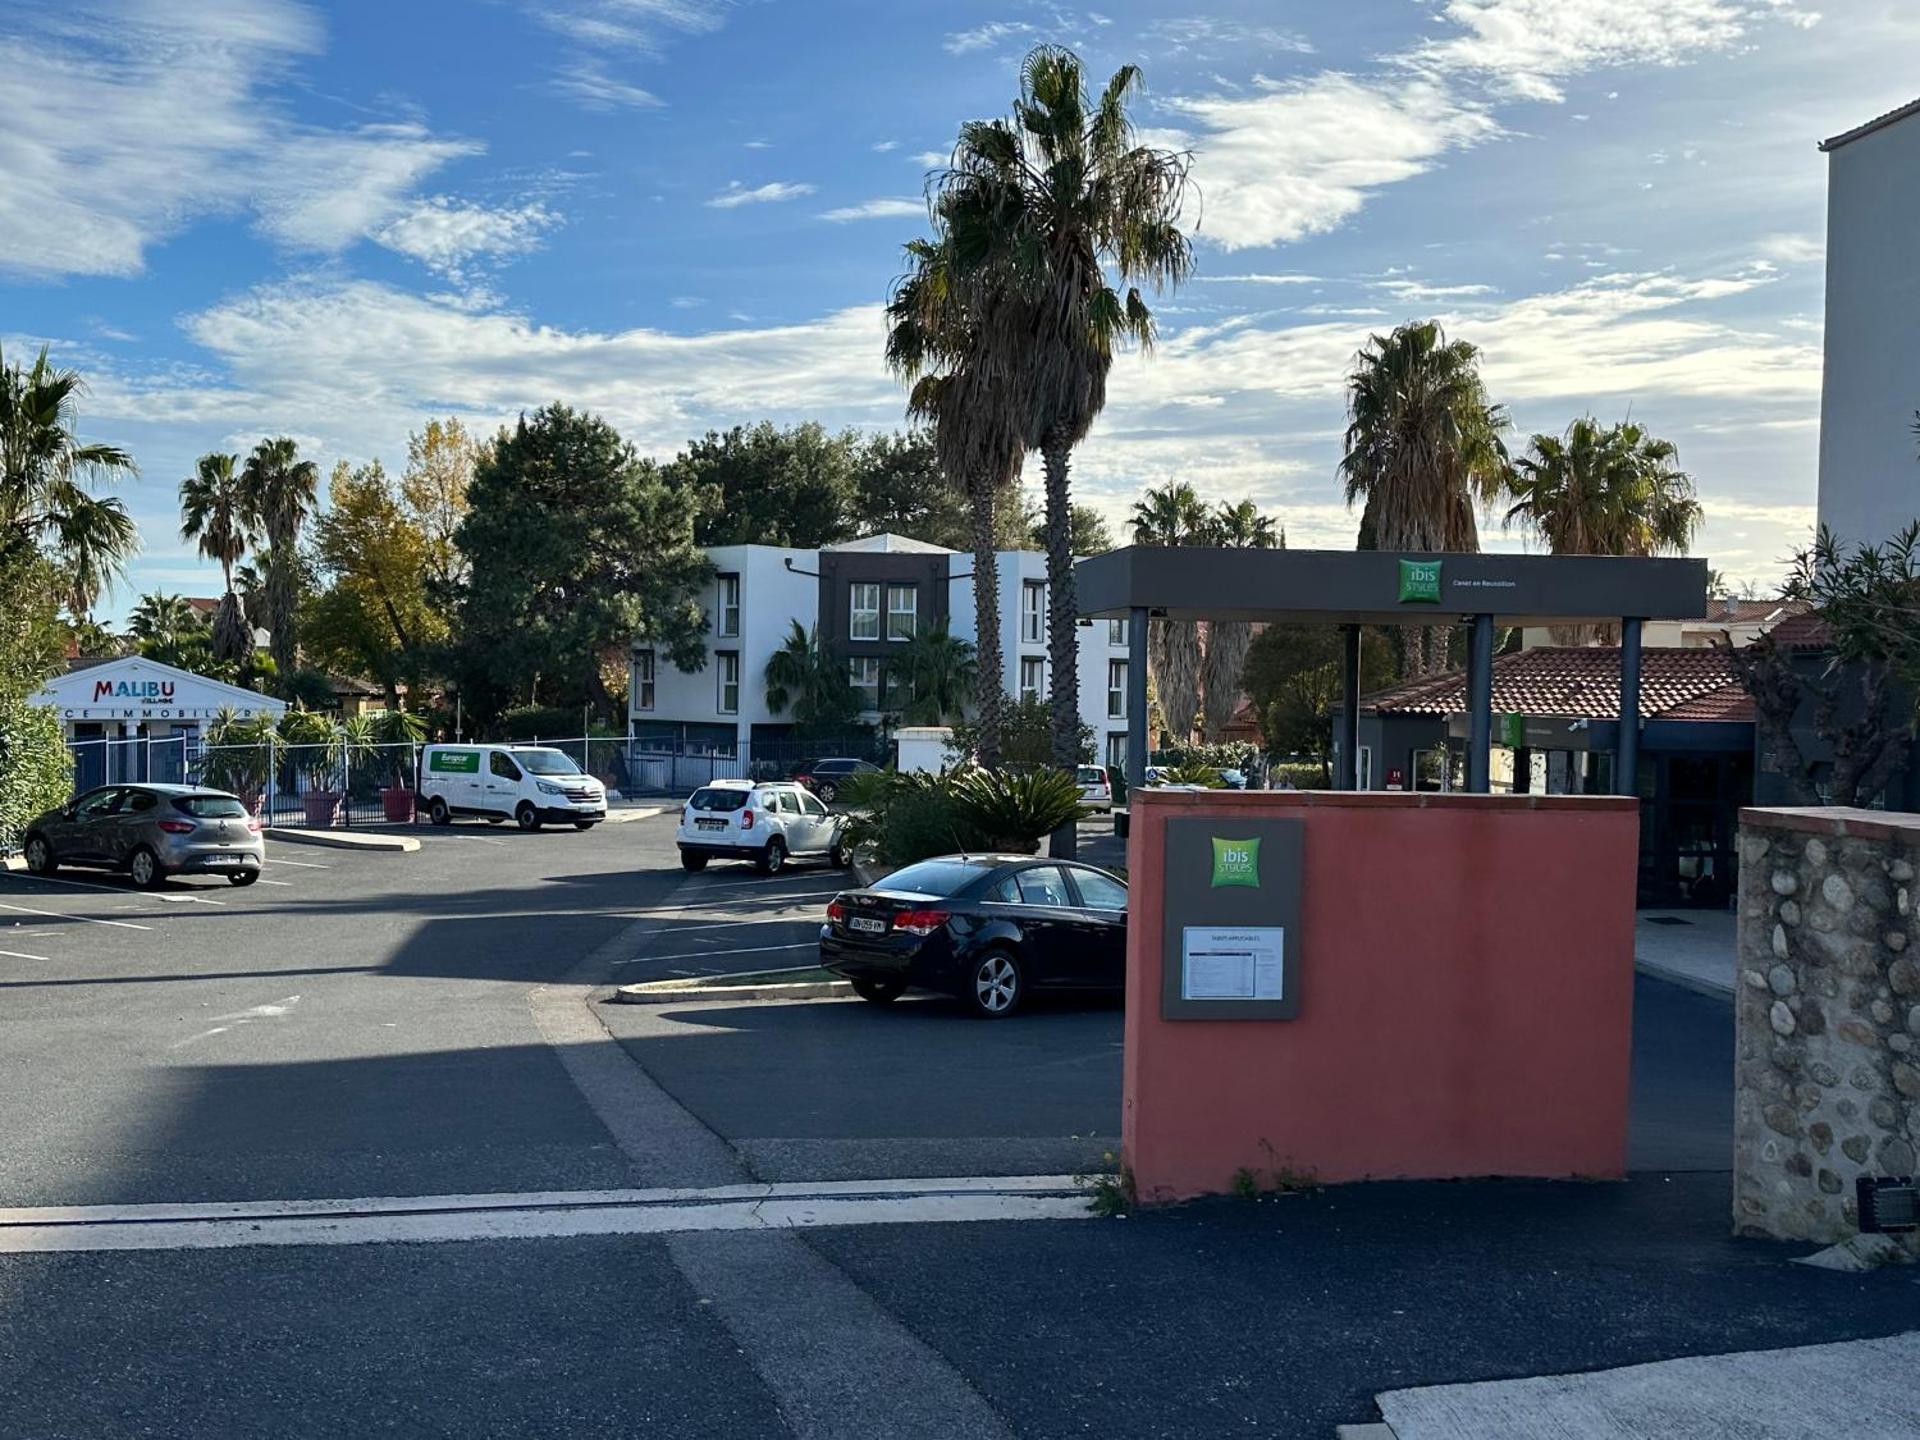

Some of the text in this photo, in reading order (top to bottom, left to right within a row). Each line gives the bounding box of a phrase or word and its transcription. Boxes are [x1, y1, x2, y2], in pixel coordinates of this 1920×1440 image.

[1410, 567, 1436, 581] ibis
[93, 681, 175, 702] MALIBU
[1223, 848, 1249, 863] ibis
